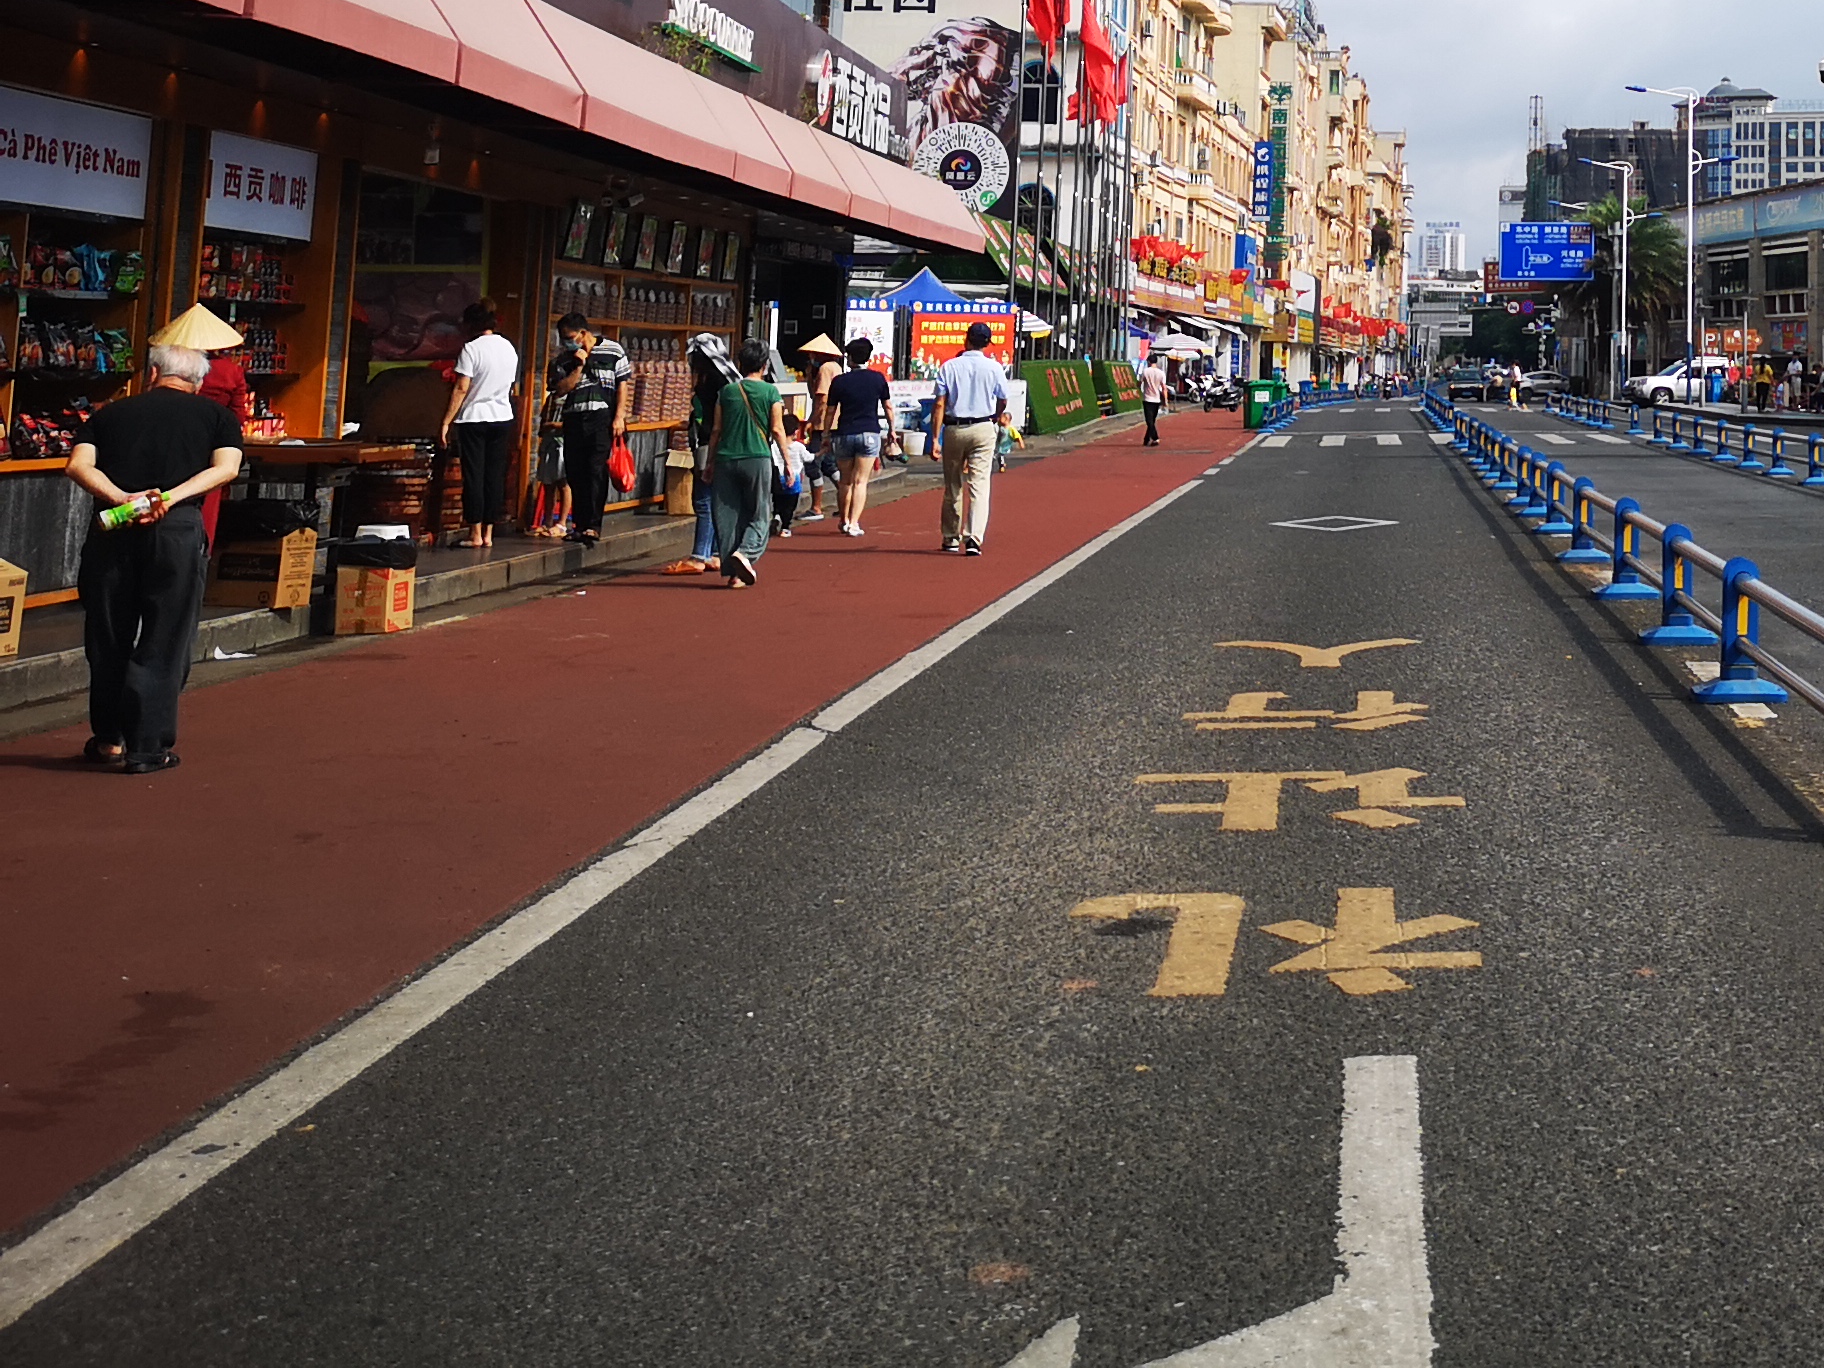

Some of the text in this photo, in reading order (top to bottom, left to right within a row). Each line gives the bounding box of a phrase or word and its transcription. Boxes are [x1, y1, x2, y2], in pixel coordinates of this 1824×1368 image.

[22, 132, 58, 166] Phê
[62, 139, 100, 175] Việt
[102, 146, 141, 179] Nam
[223, 162, 308, 211] 西贡咖啡
